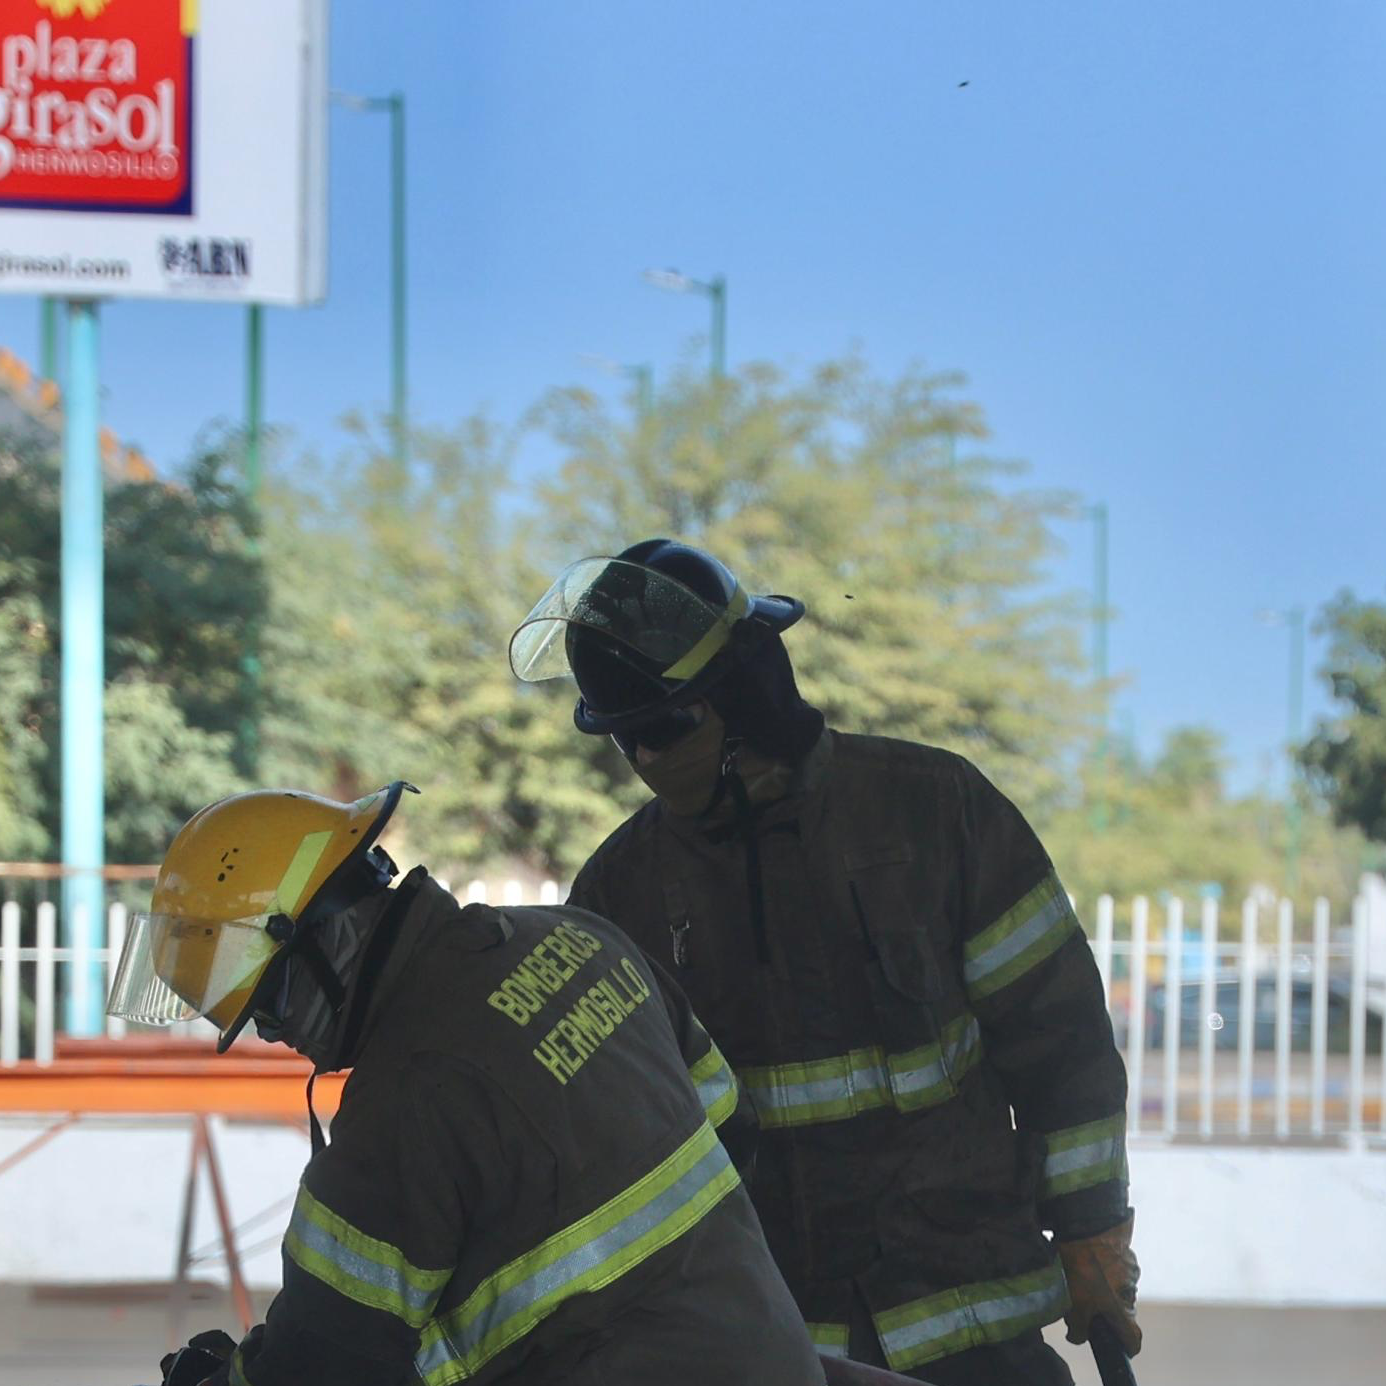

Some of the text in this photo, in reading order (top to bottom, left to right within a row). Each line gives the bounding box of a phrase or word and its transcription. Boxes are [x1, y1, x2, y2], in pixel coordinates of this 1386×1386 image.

[2, 18, 137, 91] plaza
[487, 919, 603, 1027] BOMBEROS
[532, 956, 651, 1086] HERMOSILLO
